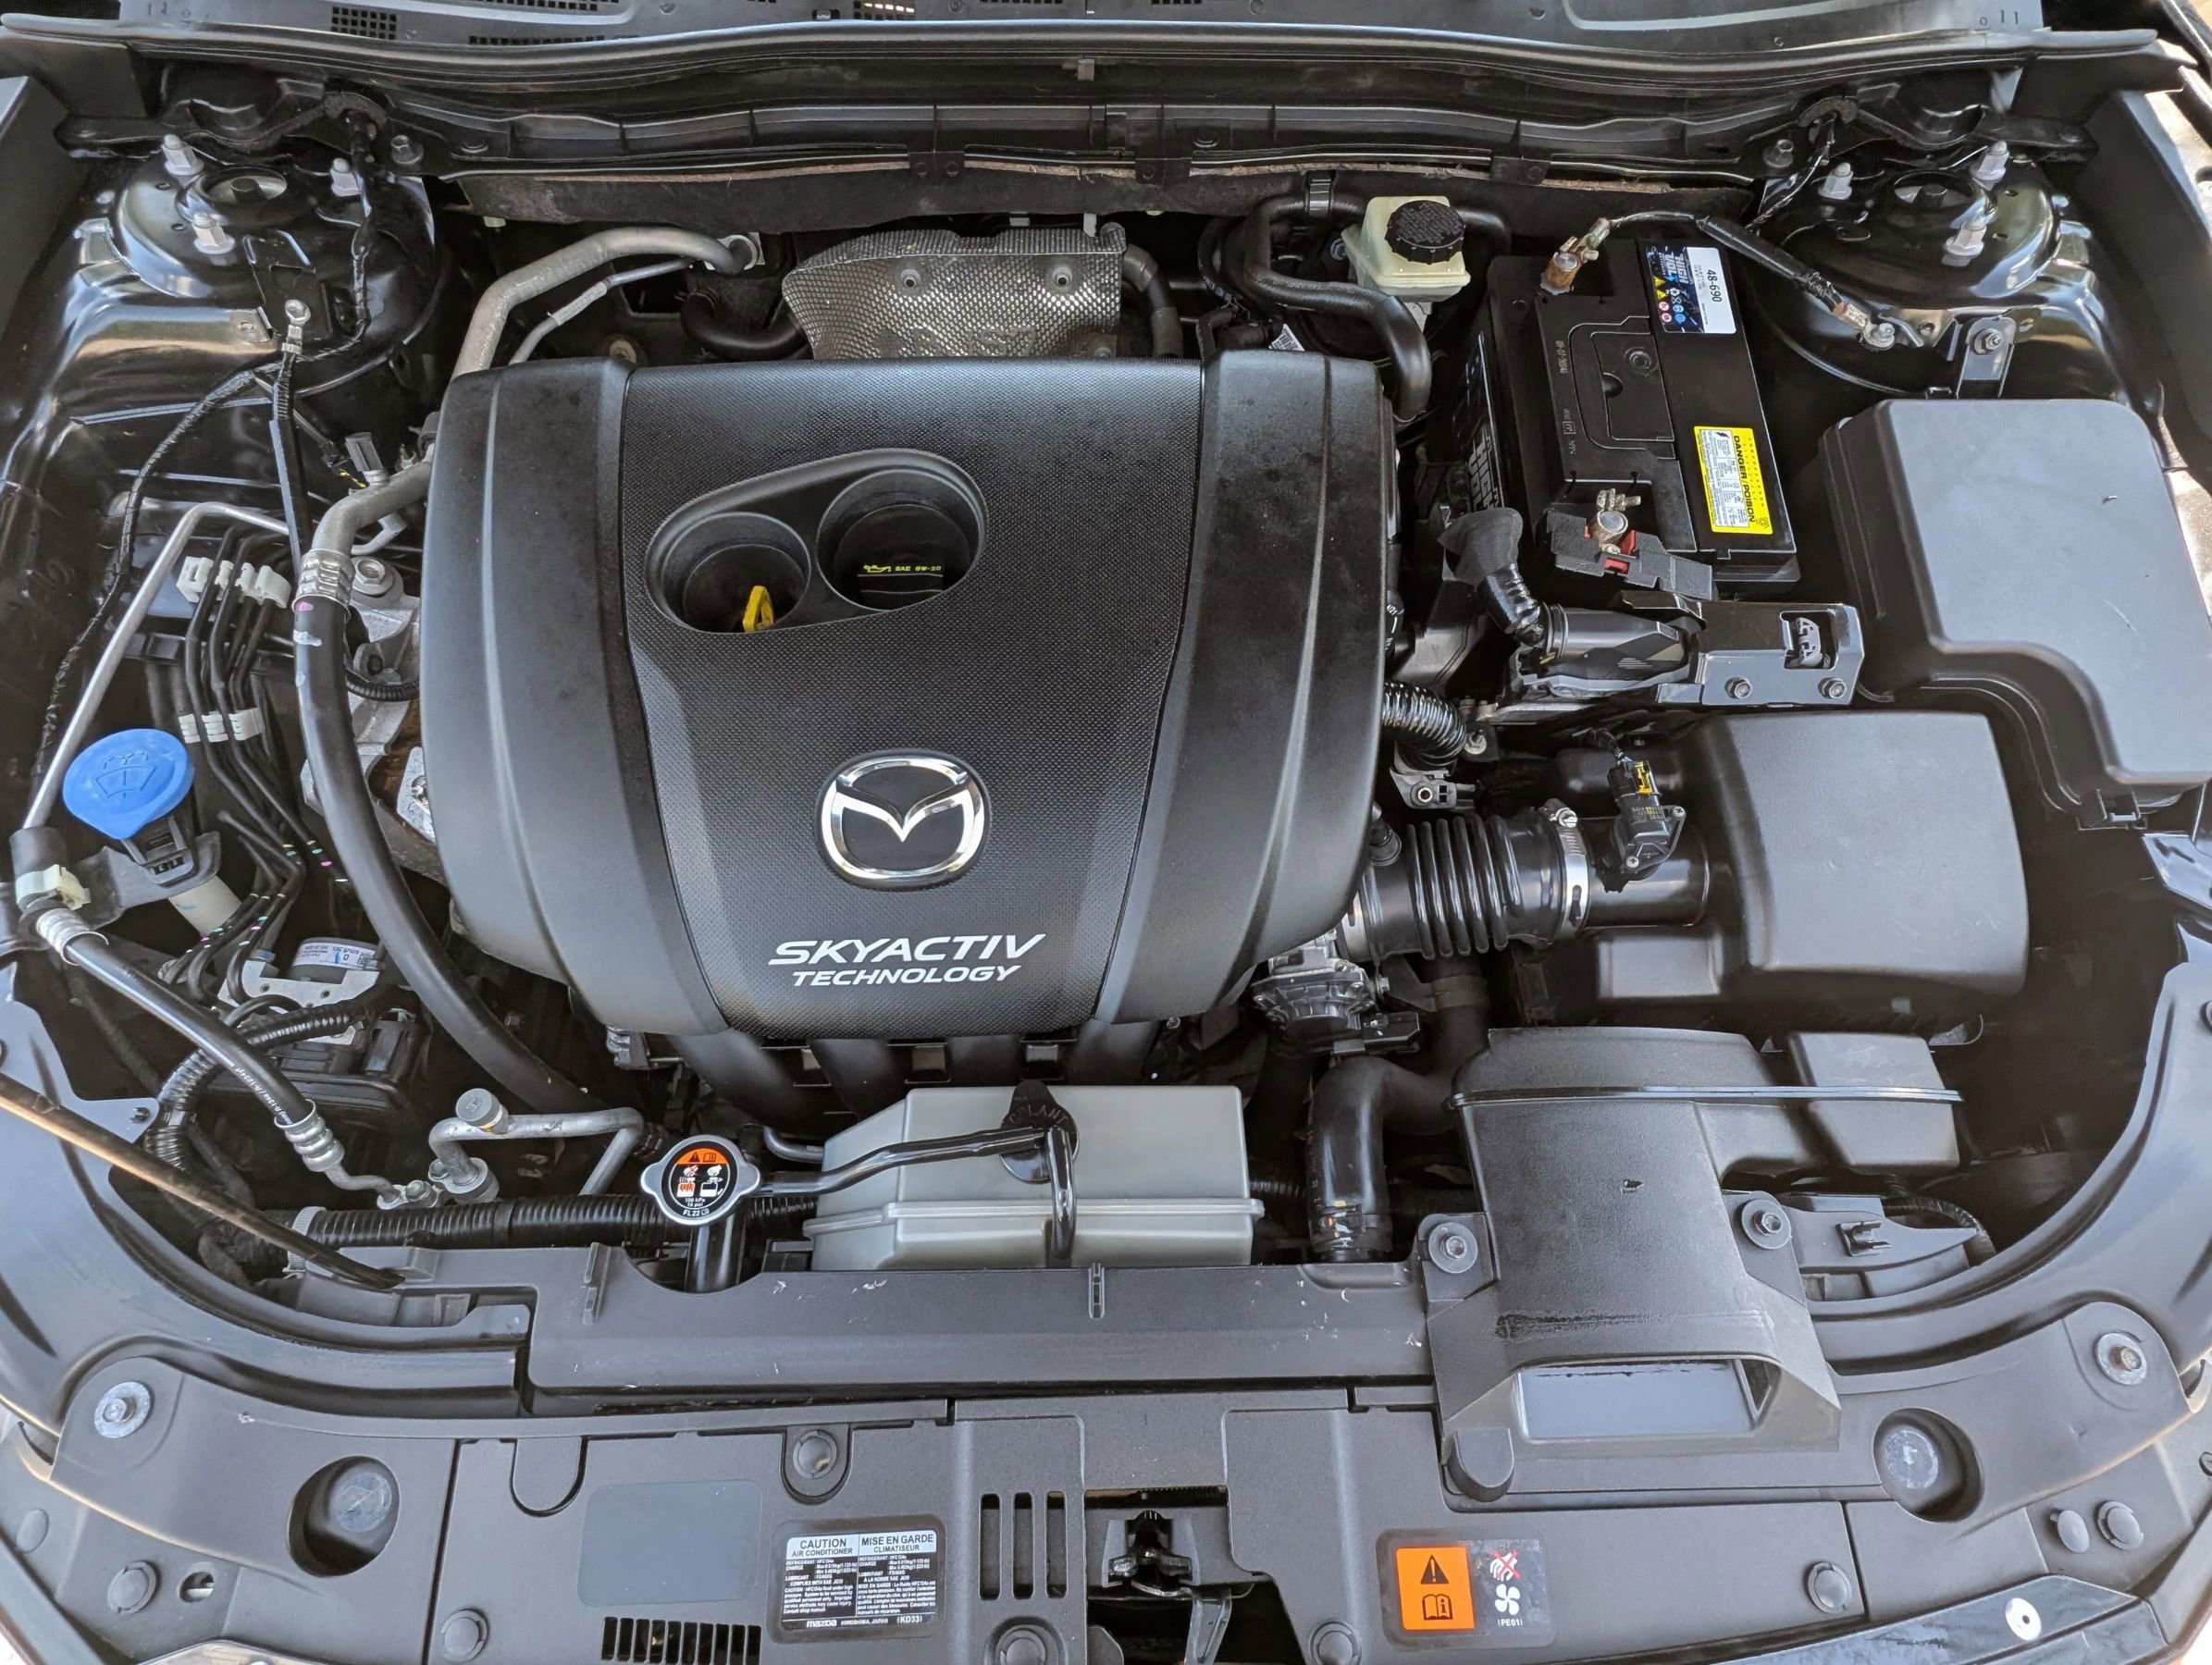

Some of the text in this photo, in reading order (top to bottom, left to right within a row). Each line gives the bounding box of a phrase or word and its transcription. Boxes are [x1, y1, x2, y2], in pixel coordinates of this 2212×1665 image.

[1674, 253, 1689, 284] HIGH
[1706, 269, 1723, 302] 48-690
[768, 933, 1046, 965] SKYACTIV
[792, 965, 1021, 987] TECHNOLOGY
[800, 1538, 846, 1549] CAUTION
[861, 1534, 933, 1547] MISE EN GARDE
[806, 1548, 853, 1557] CONDITIONER
[873, 1544, 920, 1553] CLIMATISEUR
[806, 1620, 837, 1628] mazda
[896, 1615, 923, 1624] (KD33)
